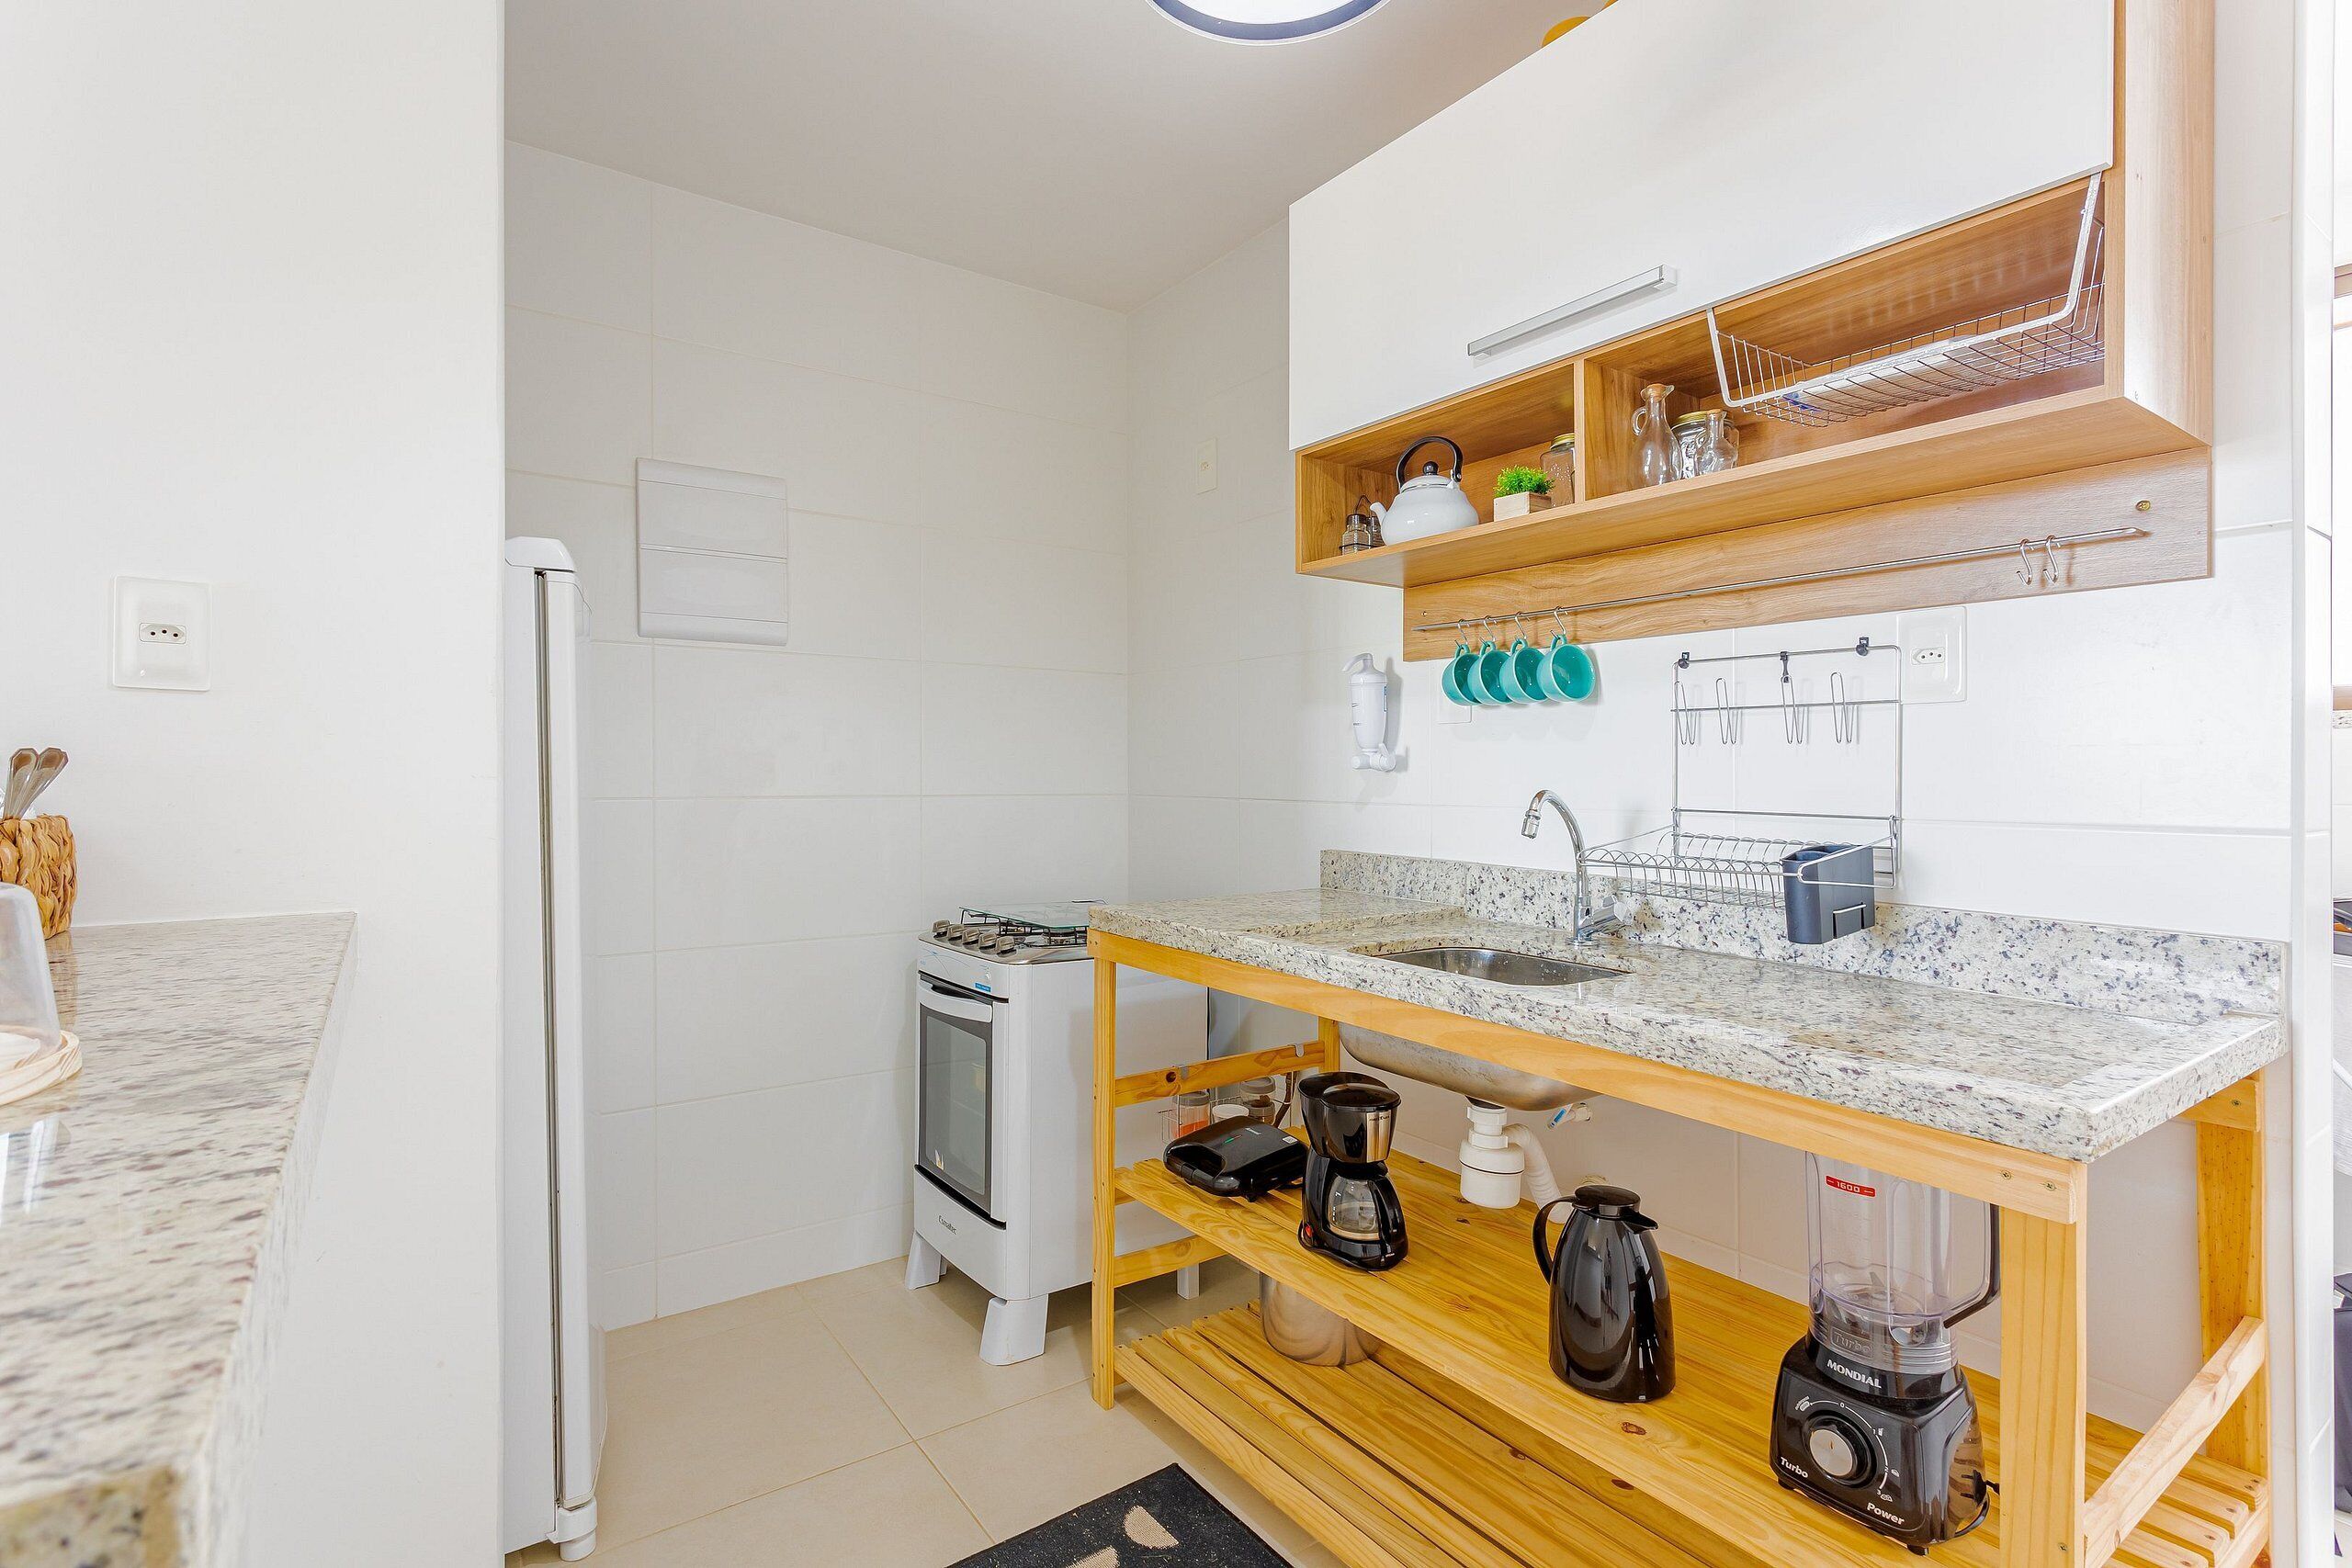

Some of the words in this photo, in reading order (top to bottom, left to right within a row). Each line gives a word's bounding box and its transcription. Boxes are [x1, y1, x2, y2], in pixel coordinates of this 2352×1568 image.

[1837, 1180, 1860, 1193] 1600
[1826, 1359, 1882, 1389] MONDIAL
[1781, 1456, 1809, 1479] Turbo
[1866, 1502, 1905, 1525] Power
